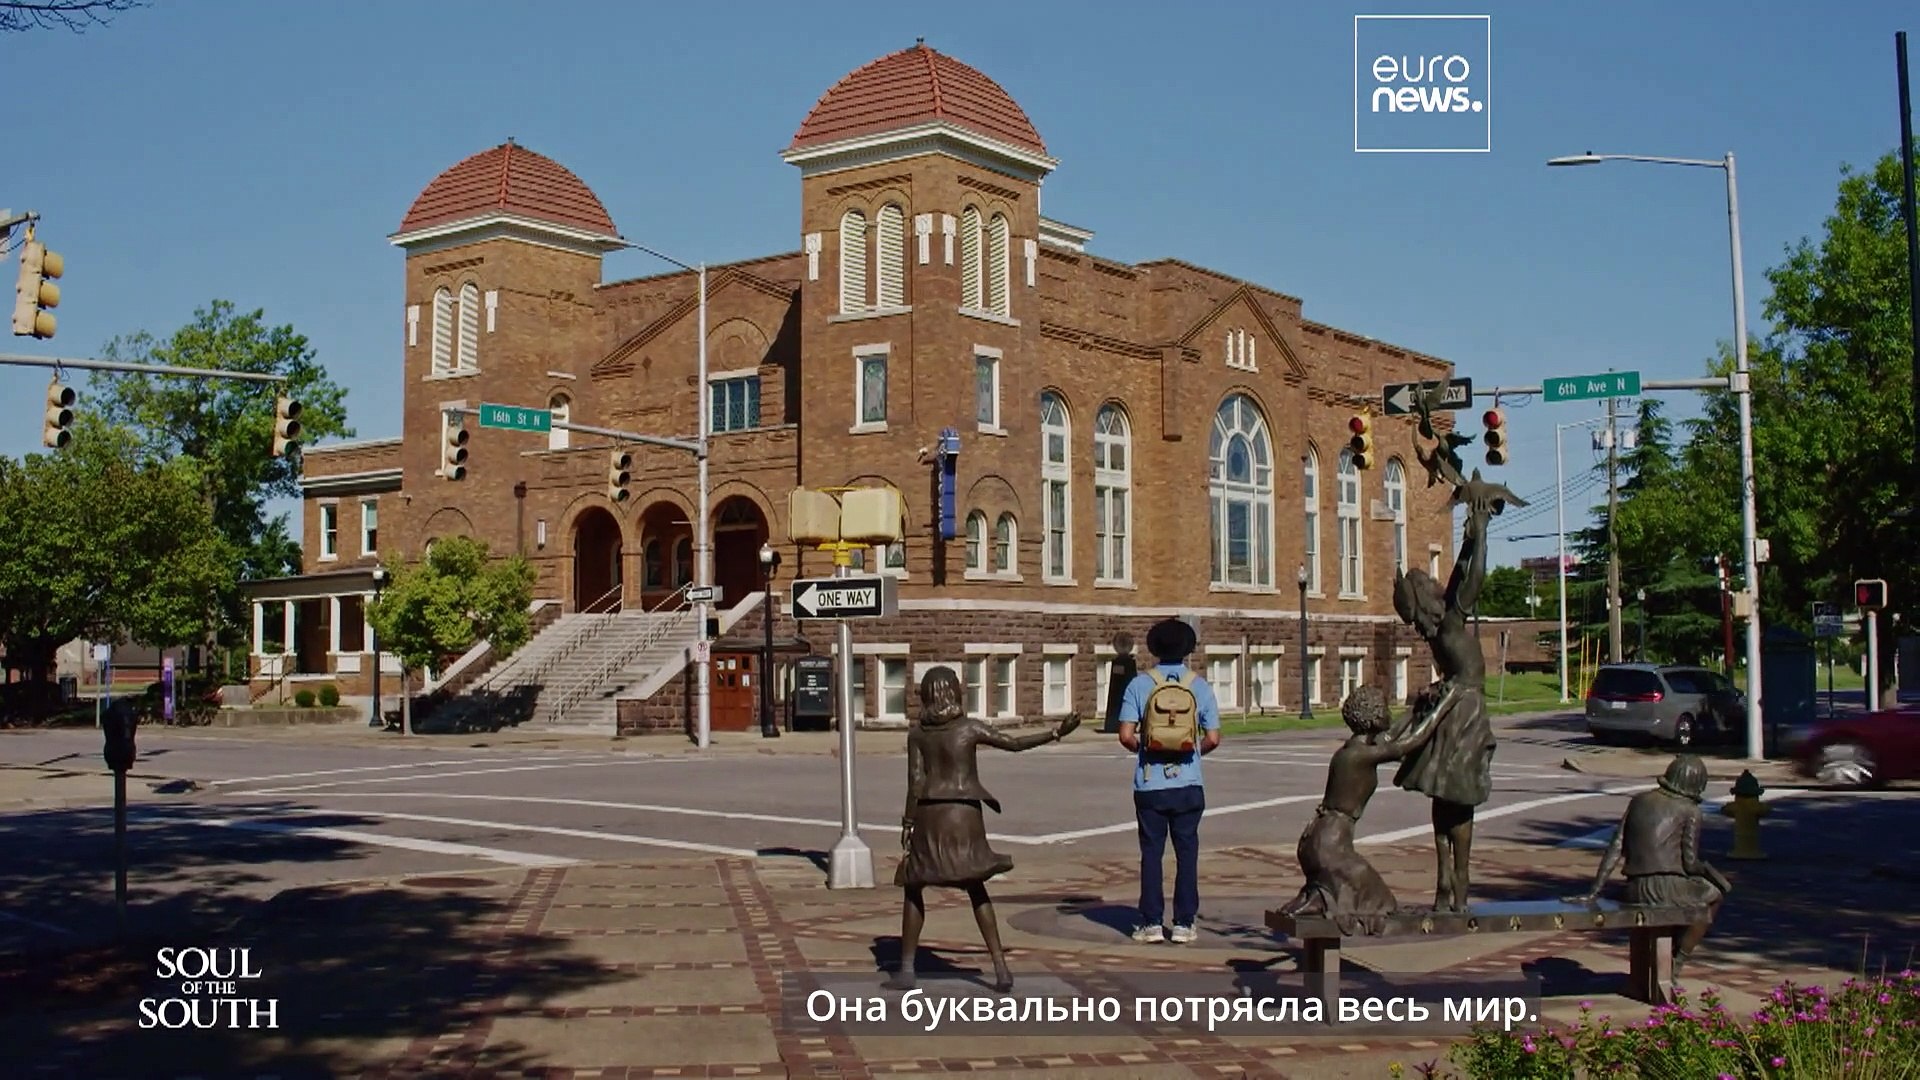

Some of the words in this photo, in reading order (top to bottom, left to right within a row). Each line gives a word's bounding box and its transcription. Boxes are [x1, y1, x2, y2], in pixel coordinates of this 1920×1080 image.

[1558, 382, 1577, 396] 6th
[1587, 380, 1607, 393] Ave
[1617, 377, 1625, 391] N
[493, 410, 511, 424] 16th
[517, 412, 527, 425] St
[534, 415, 540, 426] N
[818, 591, 842, 607] ONE
[846, 590, 872, 606] WAY
